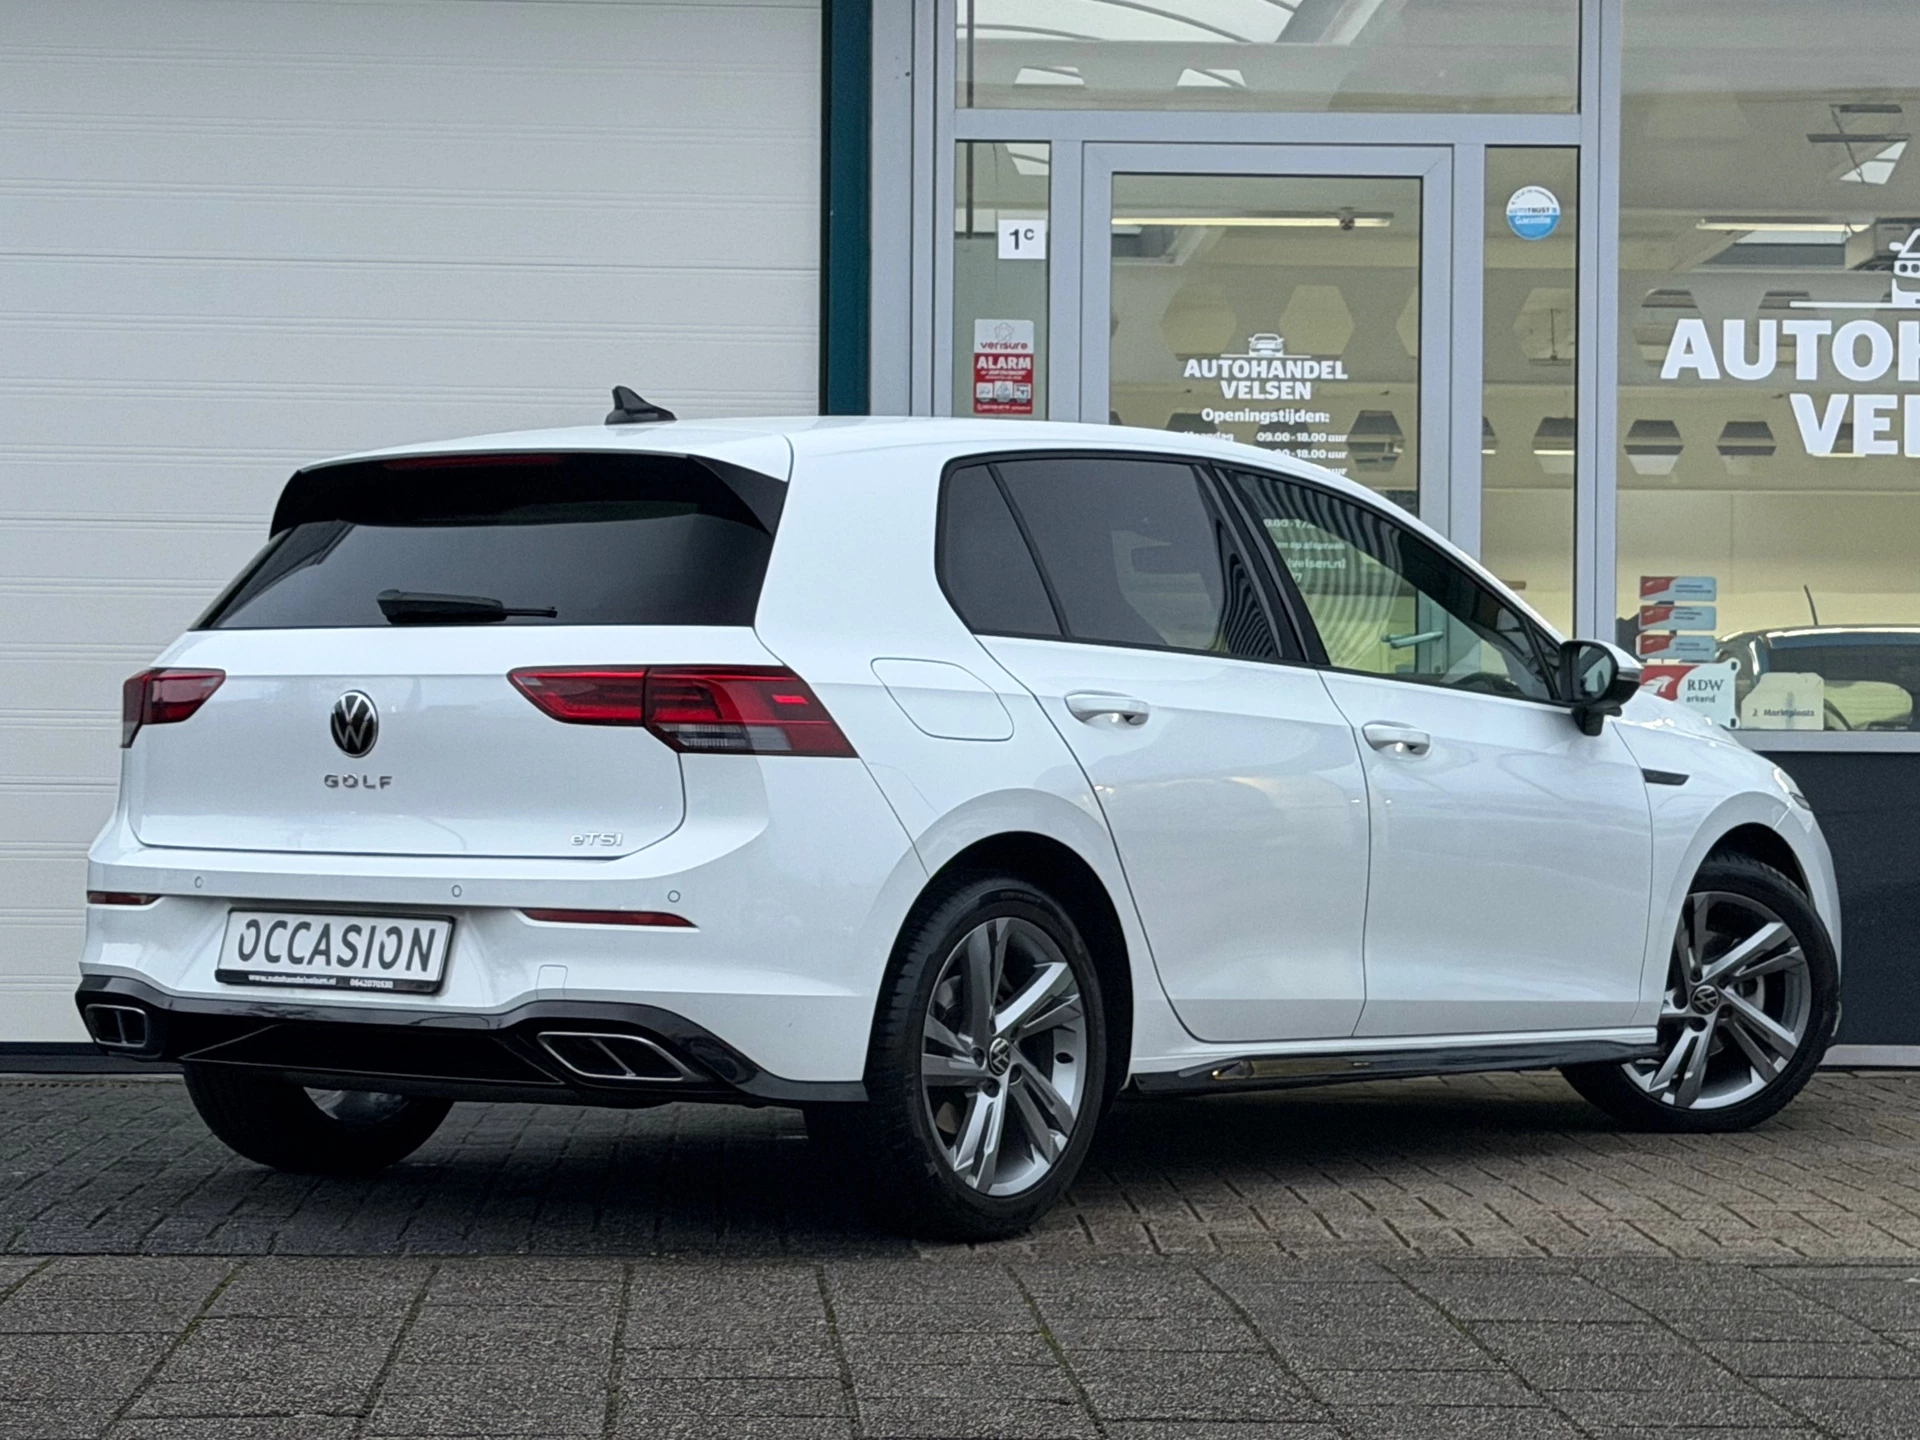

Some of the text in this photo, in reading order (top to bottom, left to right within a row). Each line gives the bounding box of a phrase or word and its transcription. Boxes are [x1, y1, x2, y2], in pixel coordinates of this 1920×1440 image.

[980, 341, 1029, 350] verisure
[976, 356, 1032, 369] ALARM
[1183, 359, 1349, 379] AUTOHANDEL
[1220, 380, 1312, 400] VELSEN
[1201, 408, 1330, 425] Openingstijden:
[1327, 434, 1348, 442] uur
[1327, 451, 1348, 459] uur
[1687, 679, 1724, 691] RDW
[1686, 694, 1716, 703] erkend
[324, 774, 393, 789] GOLF
[571, 832, 623, 846] eTSI
[237, 919, 437, 973] OCCASION
